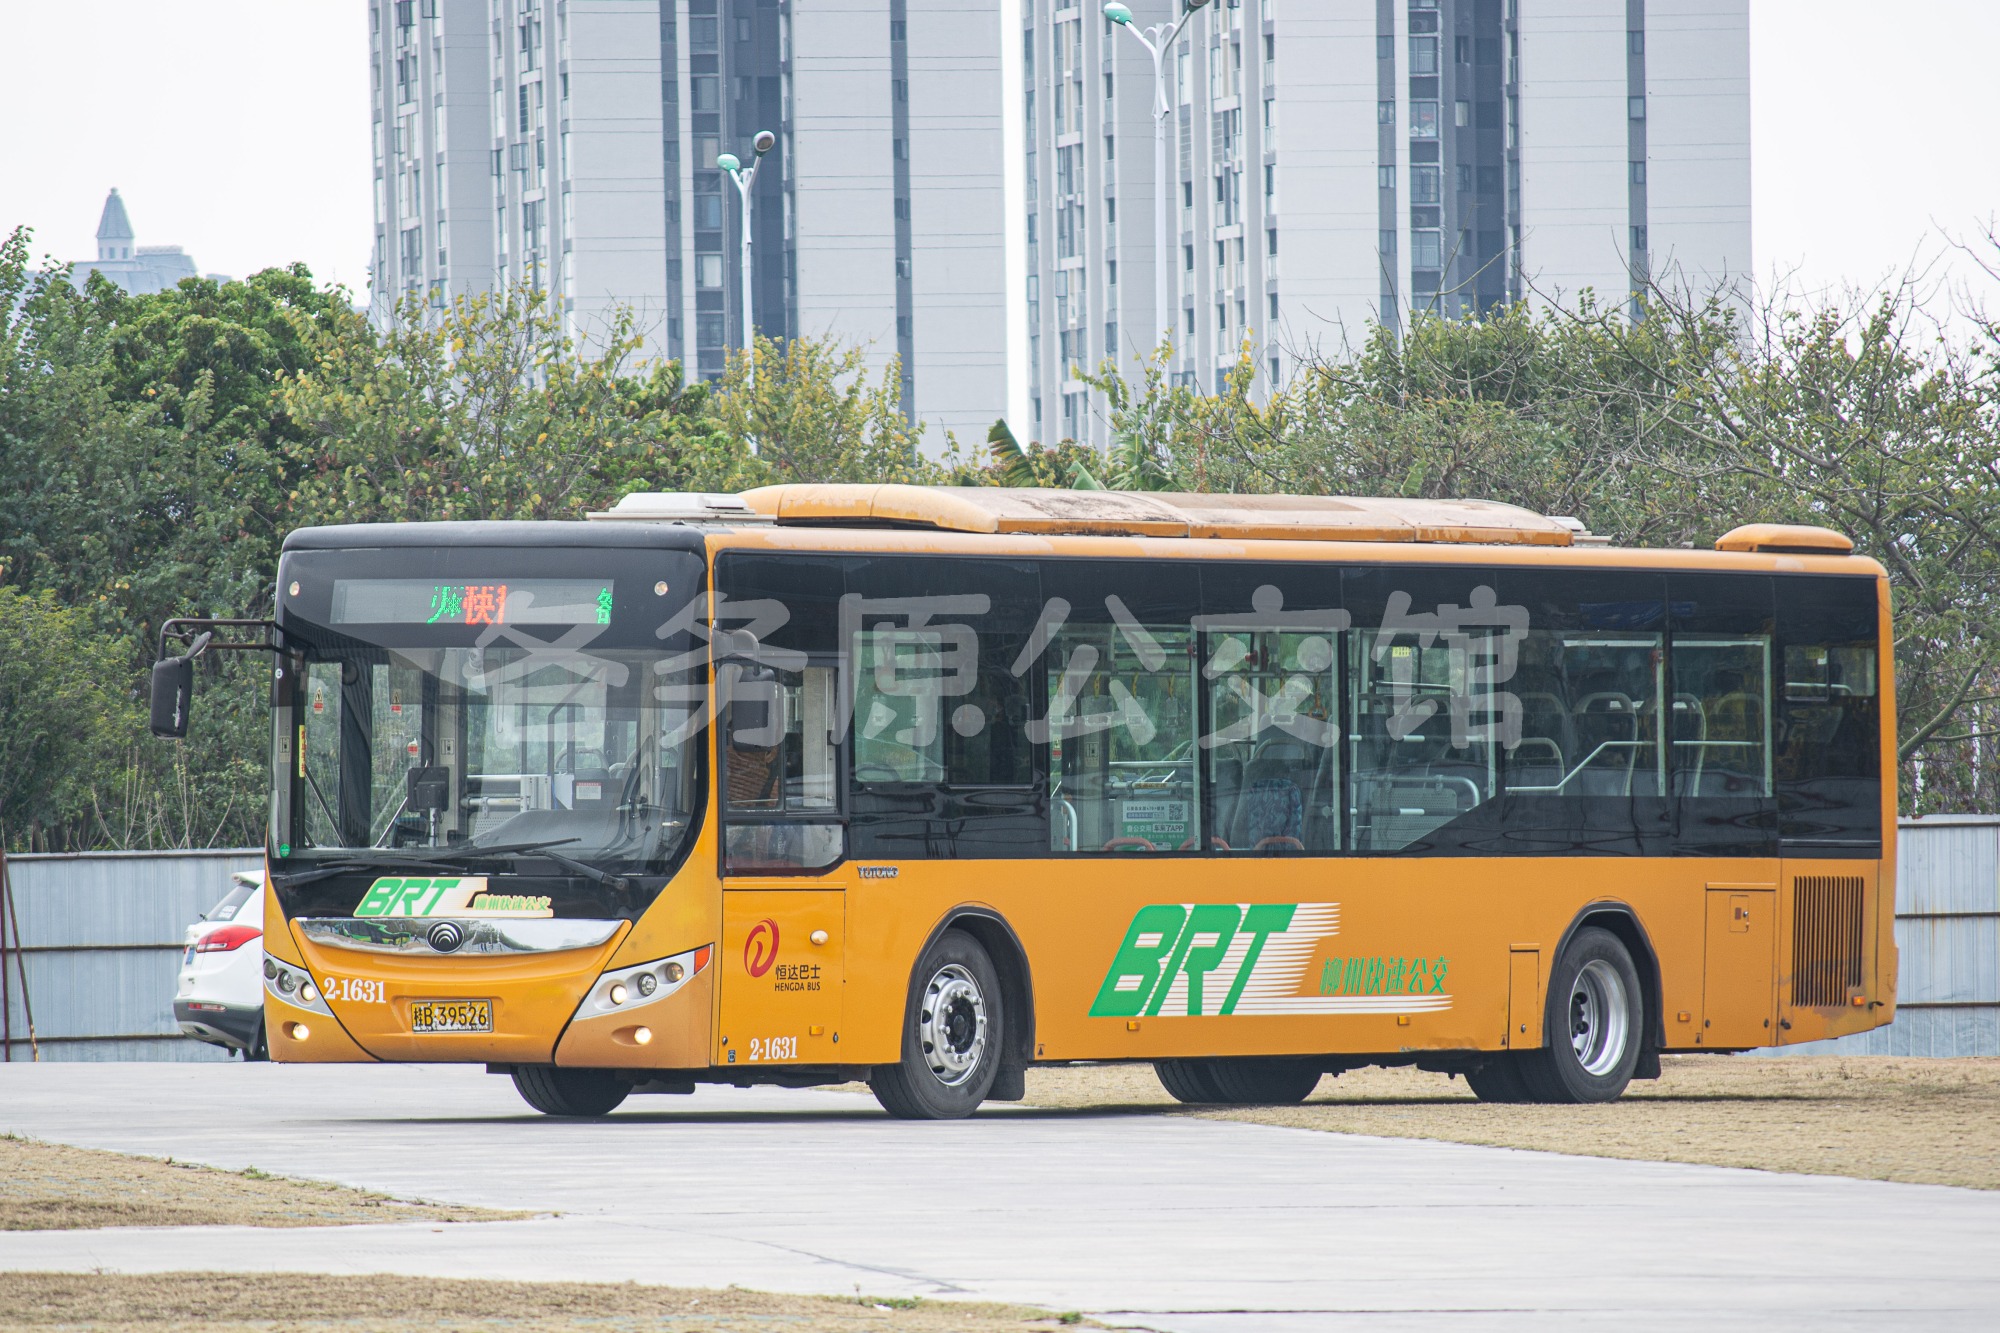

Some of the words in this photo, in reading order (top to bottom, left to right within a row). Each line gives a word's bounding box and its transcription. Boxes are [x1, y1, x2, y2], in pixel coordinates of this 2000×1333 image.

[857, 866, 899, 878] YUTONG
[355, 878, 461, 916] BRT
[474, 894, 551, 911] 柳州快速公交
[1088, 903, 1298, 1017] BRT
[775, 964, 821, 980] 恒达巴士
[1320, 956, 1450, 994] 柳州快速公交
[323, 976, 386, 1004] 2-1631
[774, 982, 805, 991] HENGDA
[807, 981, 821, 991] BUS
